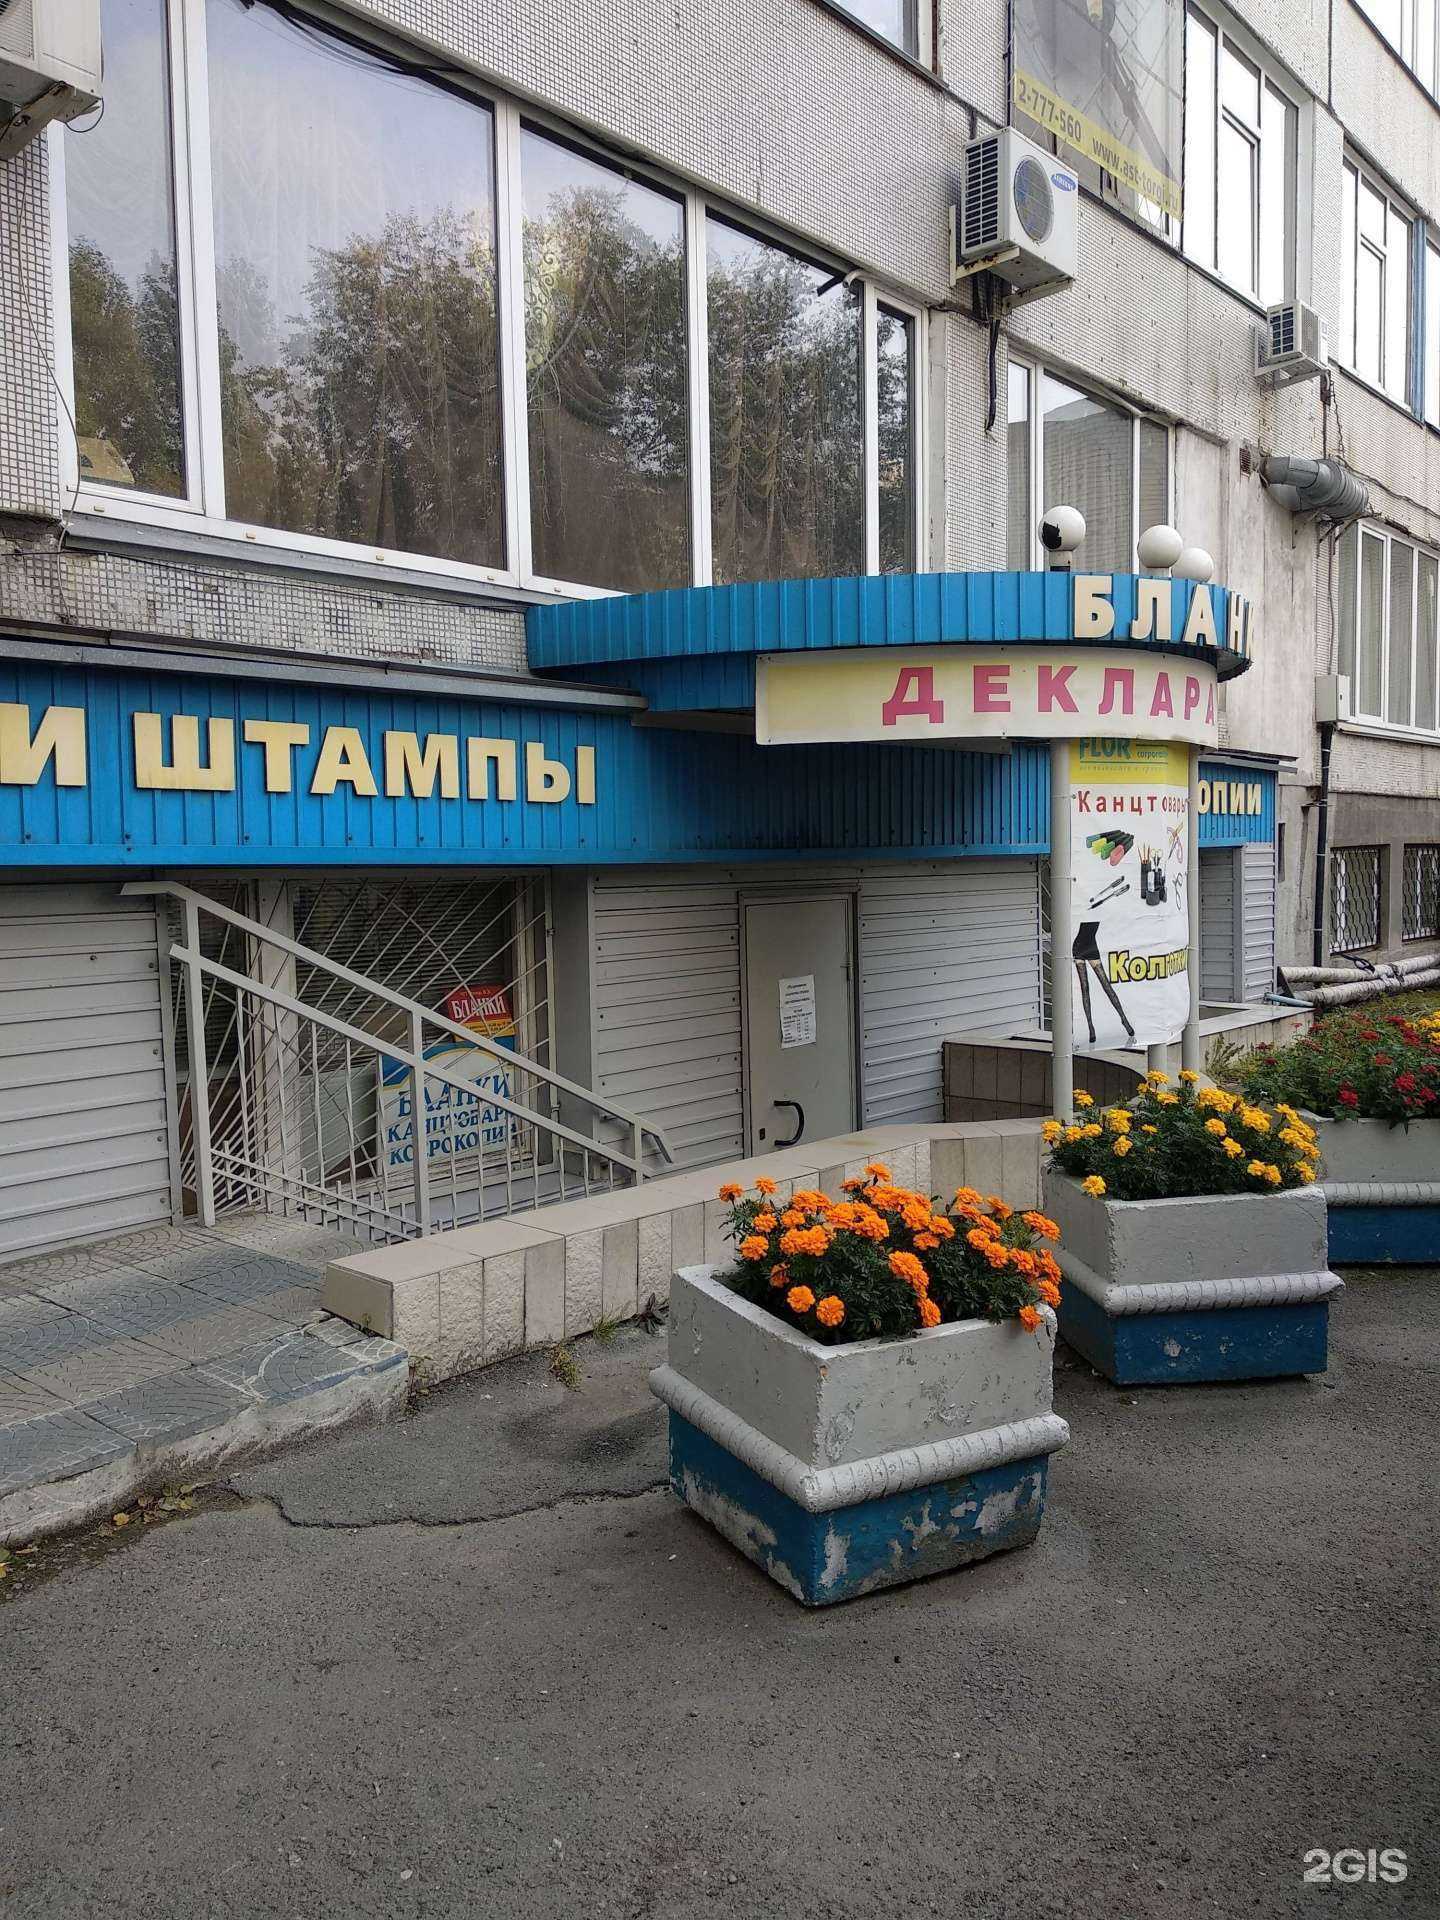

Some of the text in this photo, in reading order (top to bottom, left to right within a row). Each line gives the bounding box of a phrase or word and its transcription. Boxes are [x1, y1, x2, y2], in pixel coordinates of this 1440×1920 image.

[1018, 79, 1081, 143] 2-777-560
[882, 665, 1215, 726] ДЕКЛАРА
[0, 703, 595, 805] И ШТАМПЫ
[451, 996, 507, 1019] БЛАНКИ
